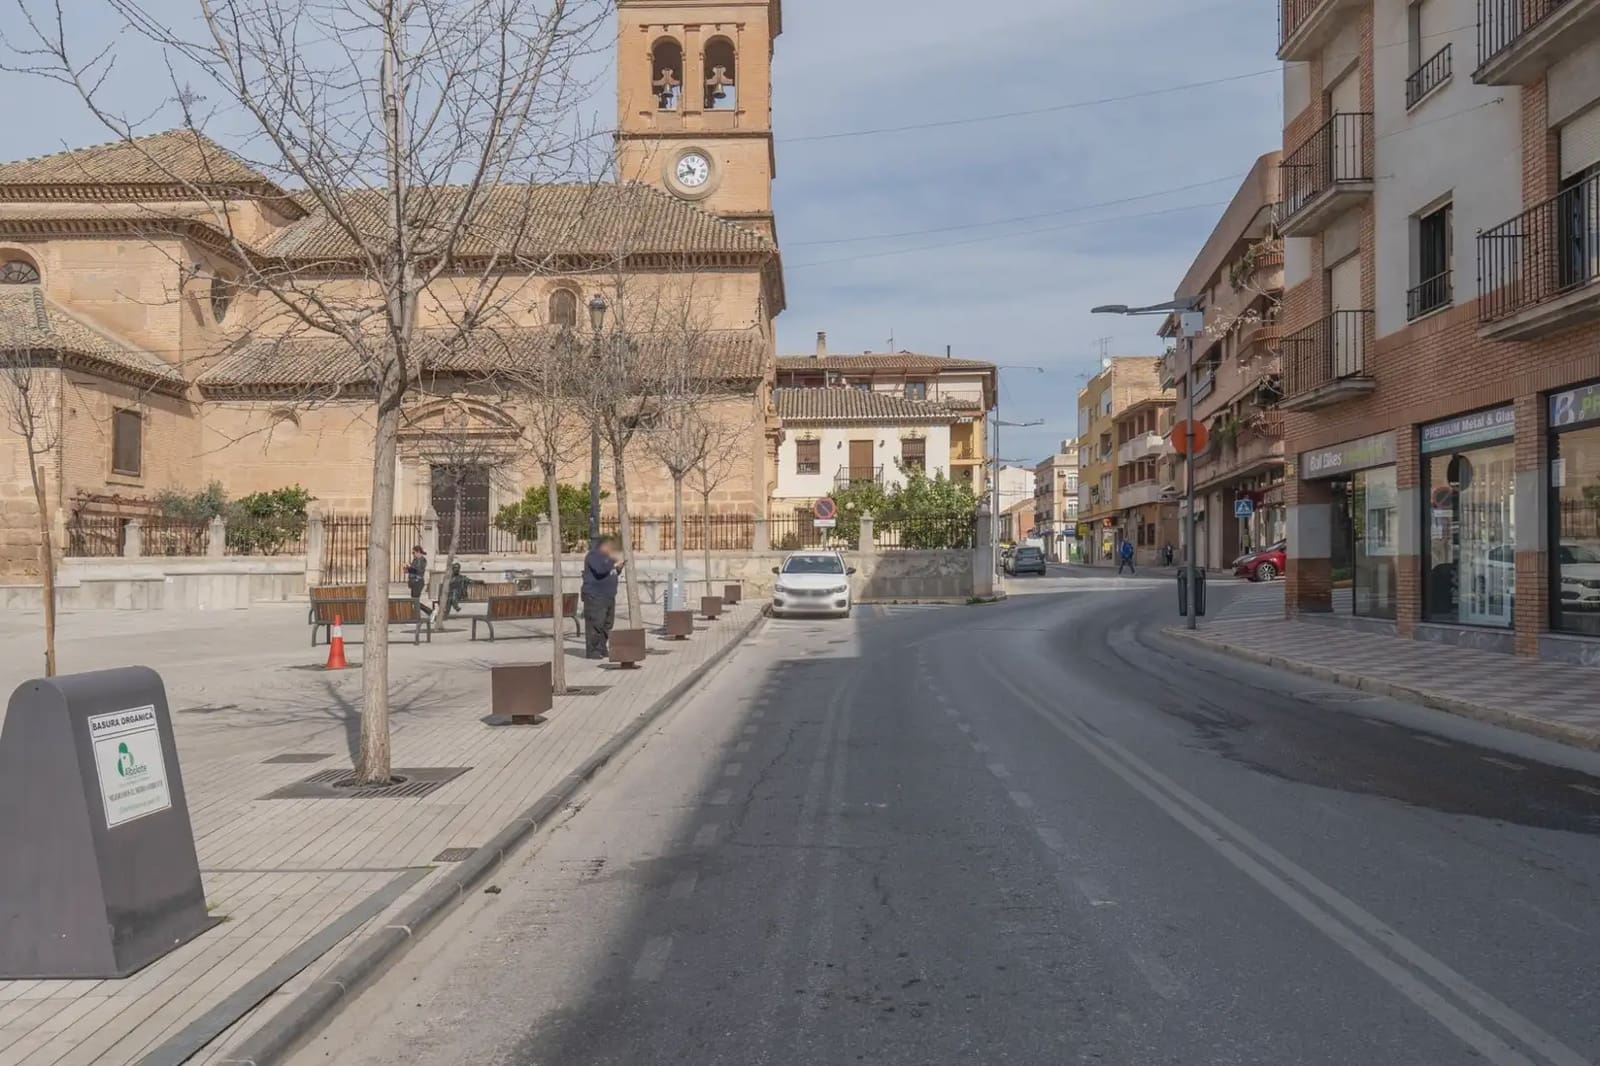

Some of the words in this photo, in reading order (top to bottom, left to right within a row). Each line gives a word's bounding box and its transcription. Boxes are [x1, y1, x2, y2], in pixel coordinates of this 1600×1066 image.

[1424, 422, 1460, 440] PREMIUM
[1462, 415, 1484, 431] Metal
[92, 718, 120, 731] BASURA
[121, 712, 153, 725] ORGANICA
